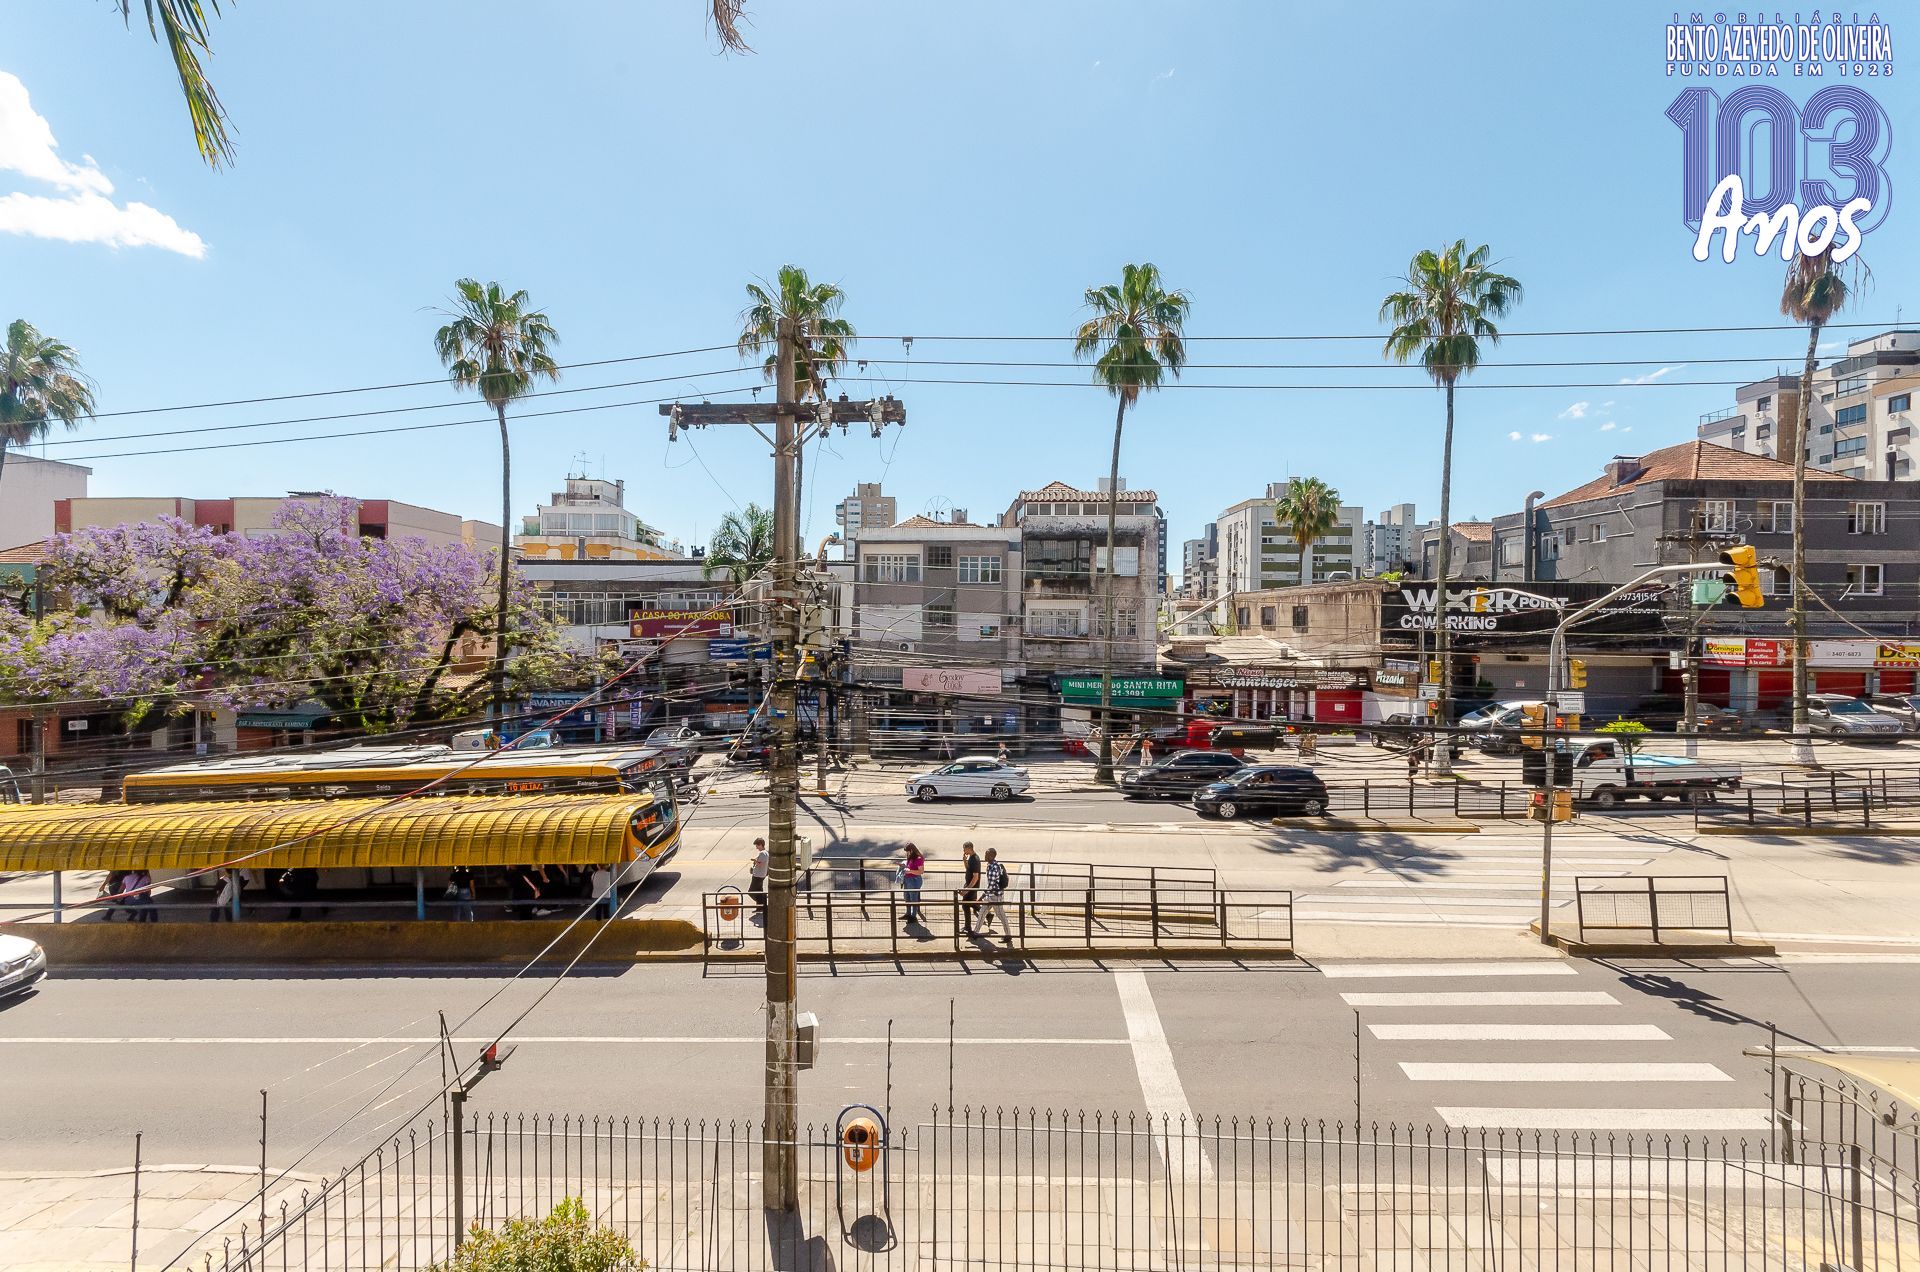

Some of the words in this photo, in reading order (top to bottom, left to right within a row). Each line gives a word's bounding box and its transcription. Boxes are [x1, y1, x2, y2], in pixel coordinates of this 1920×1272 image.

[633, 611, 640, 620] A
[642, 611, 665, 620] CASA
[1068, 681, 1085, 689] MINI
[1086, 681, 1121, 689] MERDO
[1123, 681, 1154, 690] SANTA
[1156, 681, 1178, 690] RITA
